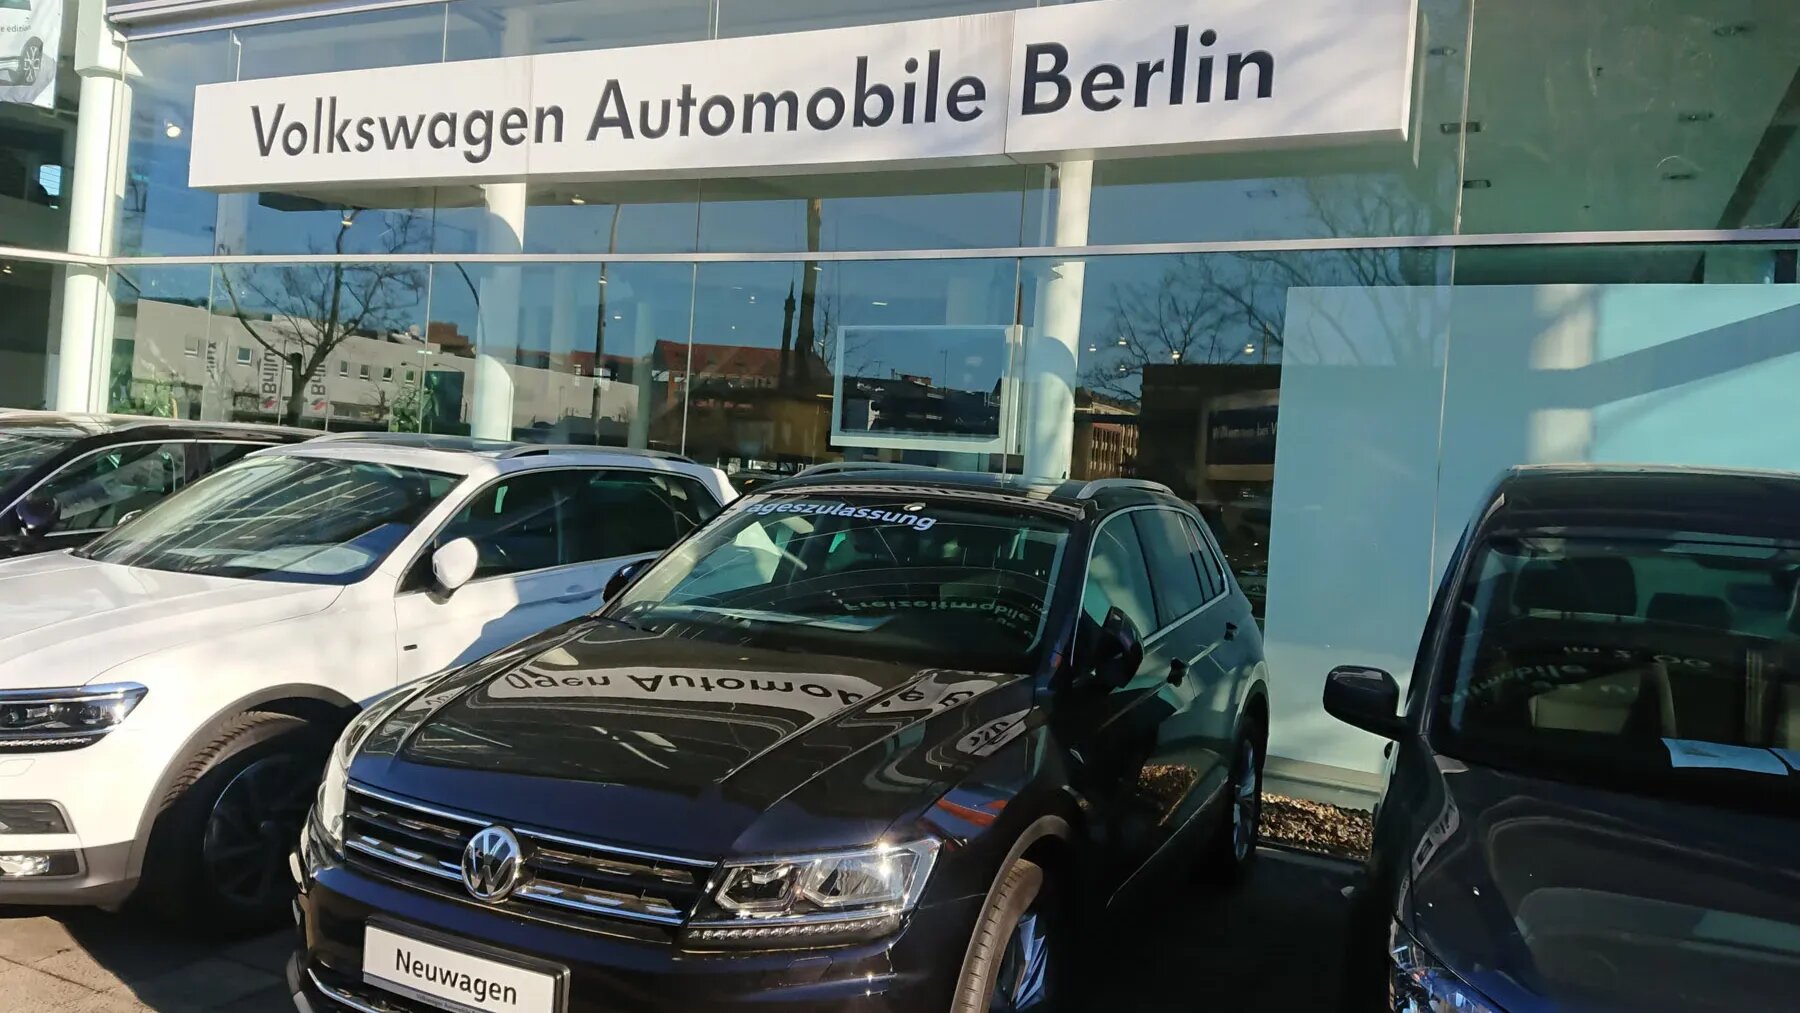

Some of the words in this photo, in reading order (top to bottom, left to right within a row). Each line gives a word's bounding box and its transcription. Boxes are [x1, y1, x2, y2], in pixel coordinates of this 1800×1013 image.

[250, 96, 564, 163] Volkswagen
[587, 50, 986, 141] Automobile
[1020, 24, 1274, 116] Berlin
[396, 948, 517, 1005] Neuwagen
